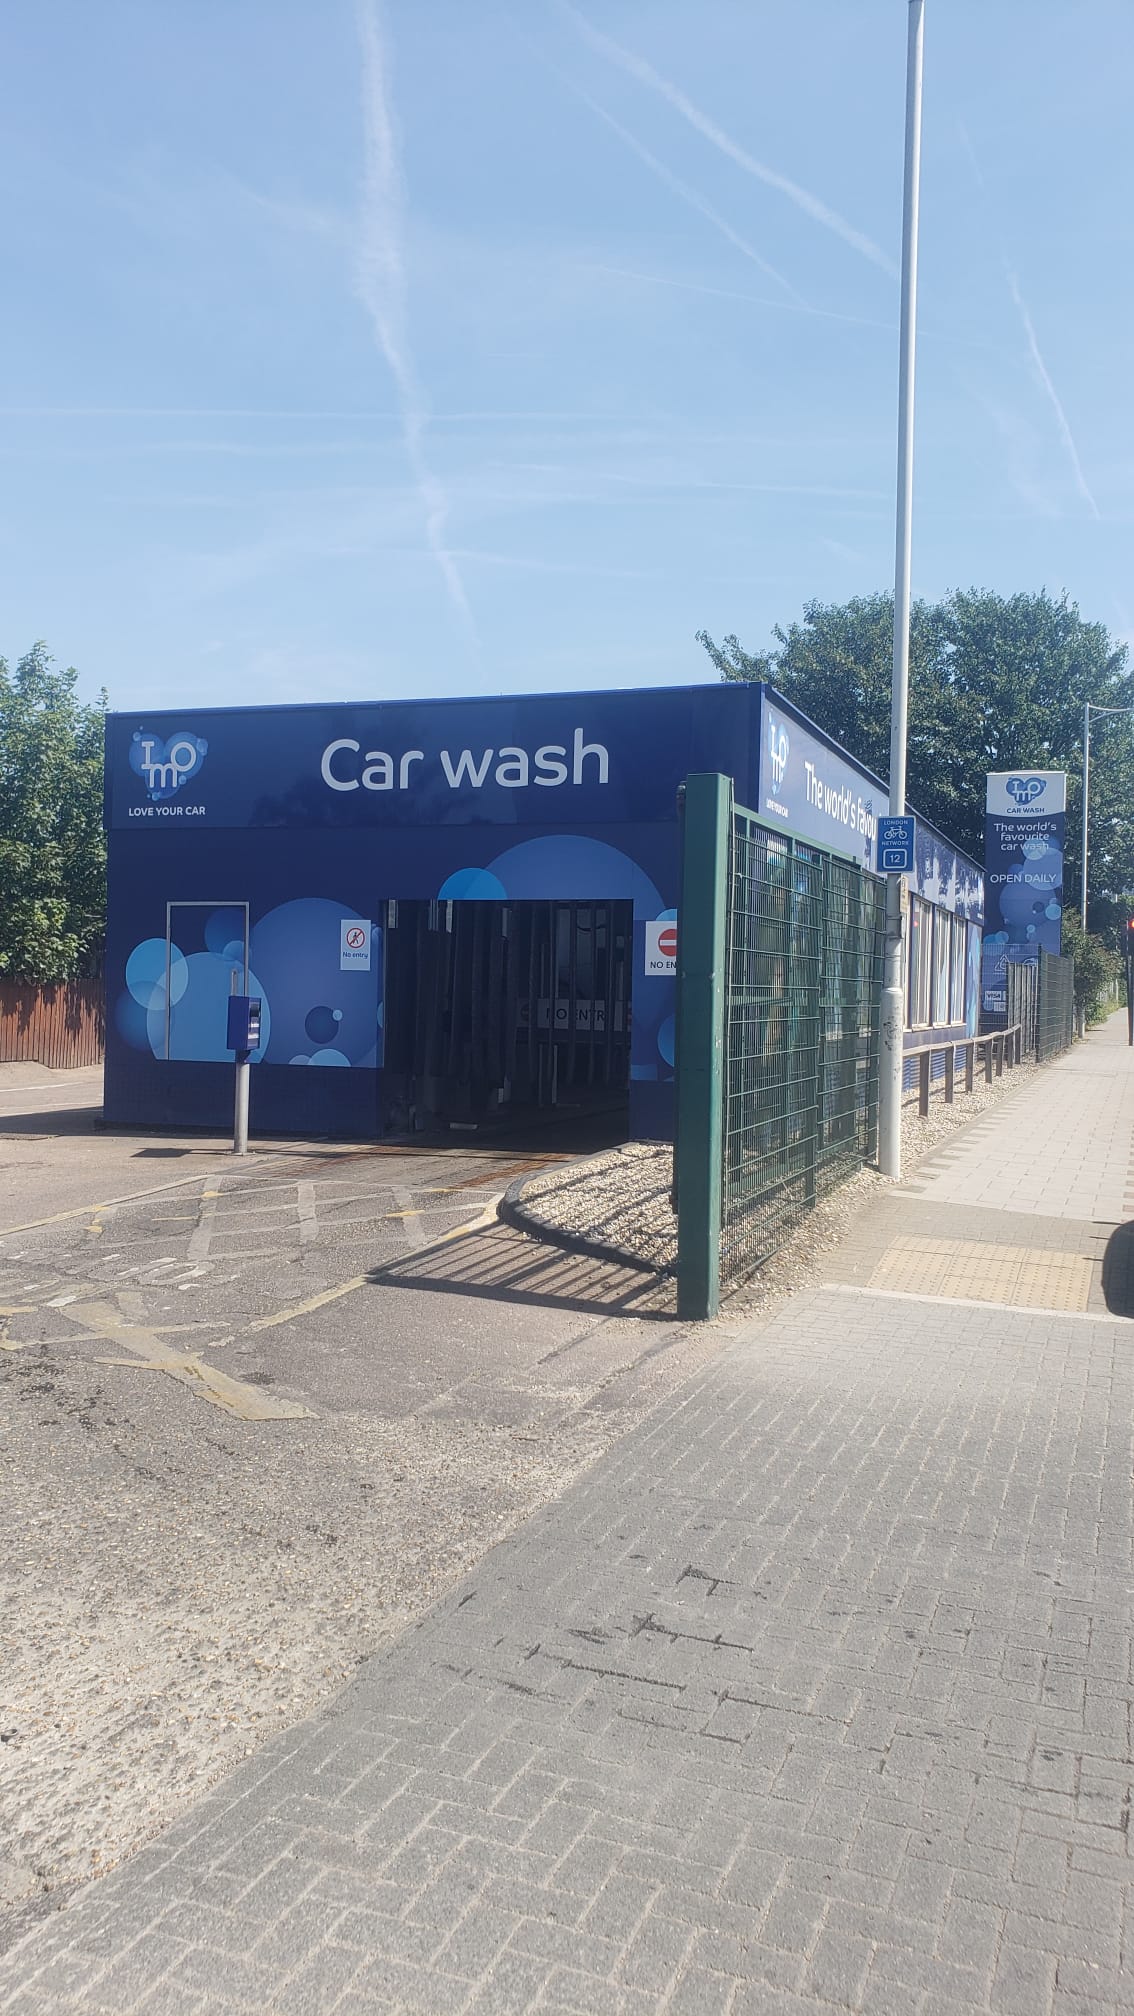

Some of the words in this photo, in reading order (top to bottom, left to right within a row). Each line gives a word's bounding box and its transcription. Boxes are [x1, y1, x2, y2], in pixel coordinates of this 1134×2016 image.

[321, 738, 425, 792] Car
[440, 727, 609, 788] wash
[804, 760, 823, 810] The
[824, 785, 856, 829] world's
[128, 807, 154, 817] LOVE
[155, 807, 183, 816] YOUR
[185, 806, 206, 816] CAR
[993, 822, 1015, 832] The
[1016, 822, 1057, 831] world's
[1000, 832, 1050, 841] favourite
[1000, 843, 1017, 851] car
[1020, 841, 1049, 850] wash
[890, 854, 901, 863] 12
[990, 874, 1022, 884] OPEN
[1024, 873, 1057, 883] DAILY
[650, 961, 663, 969] NO
